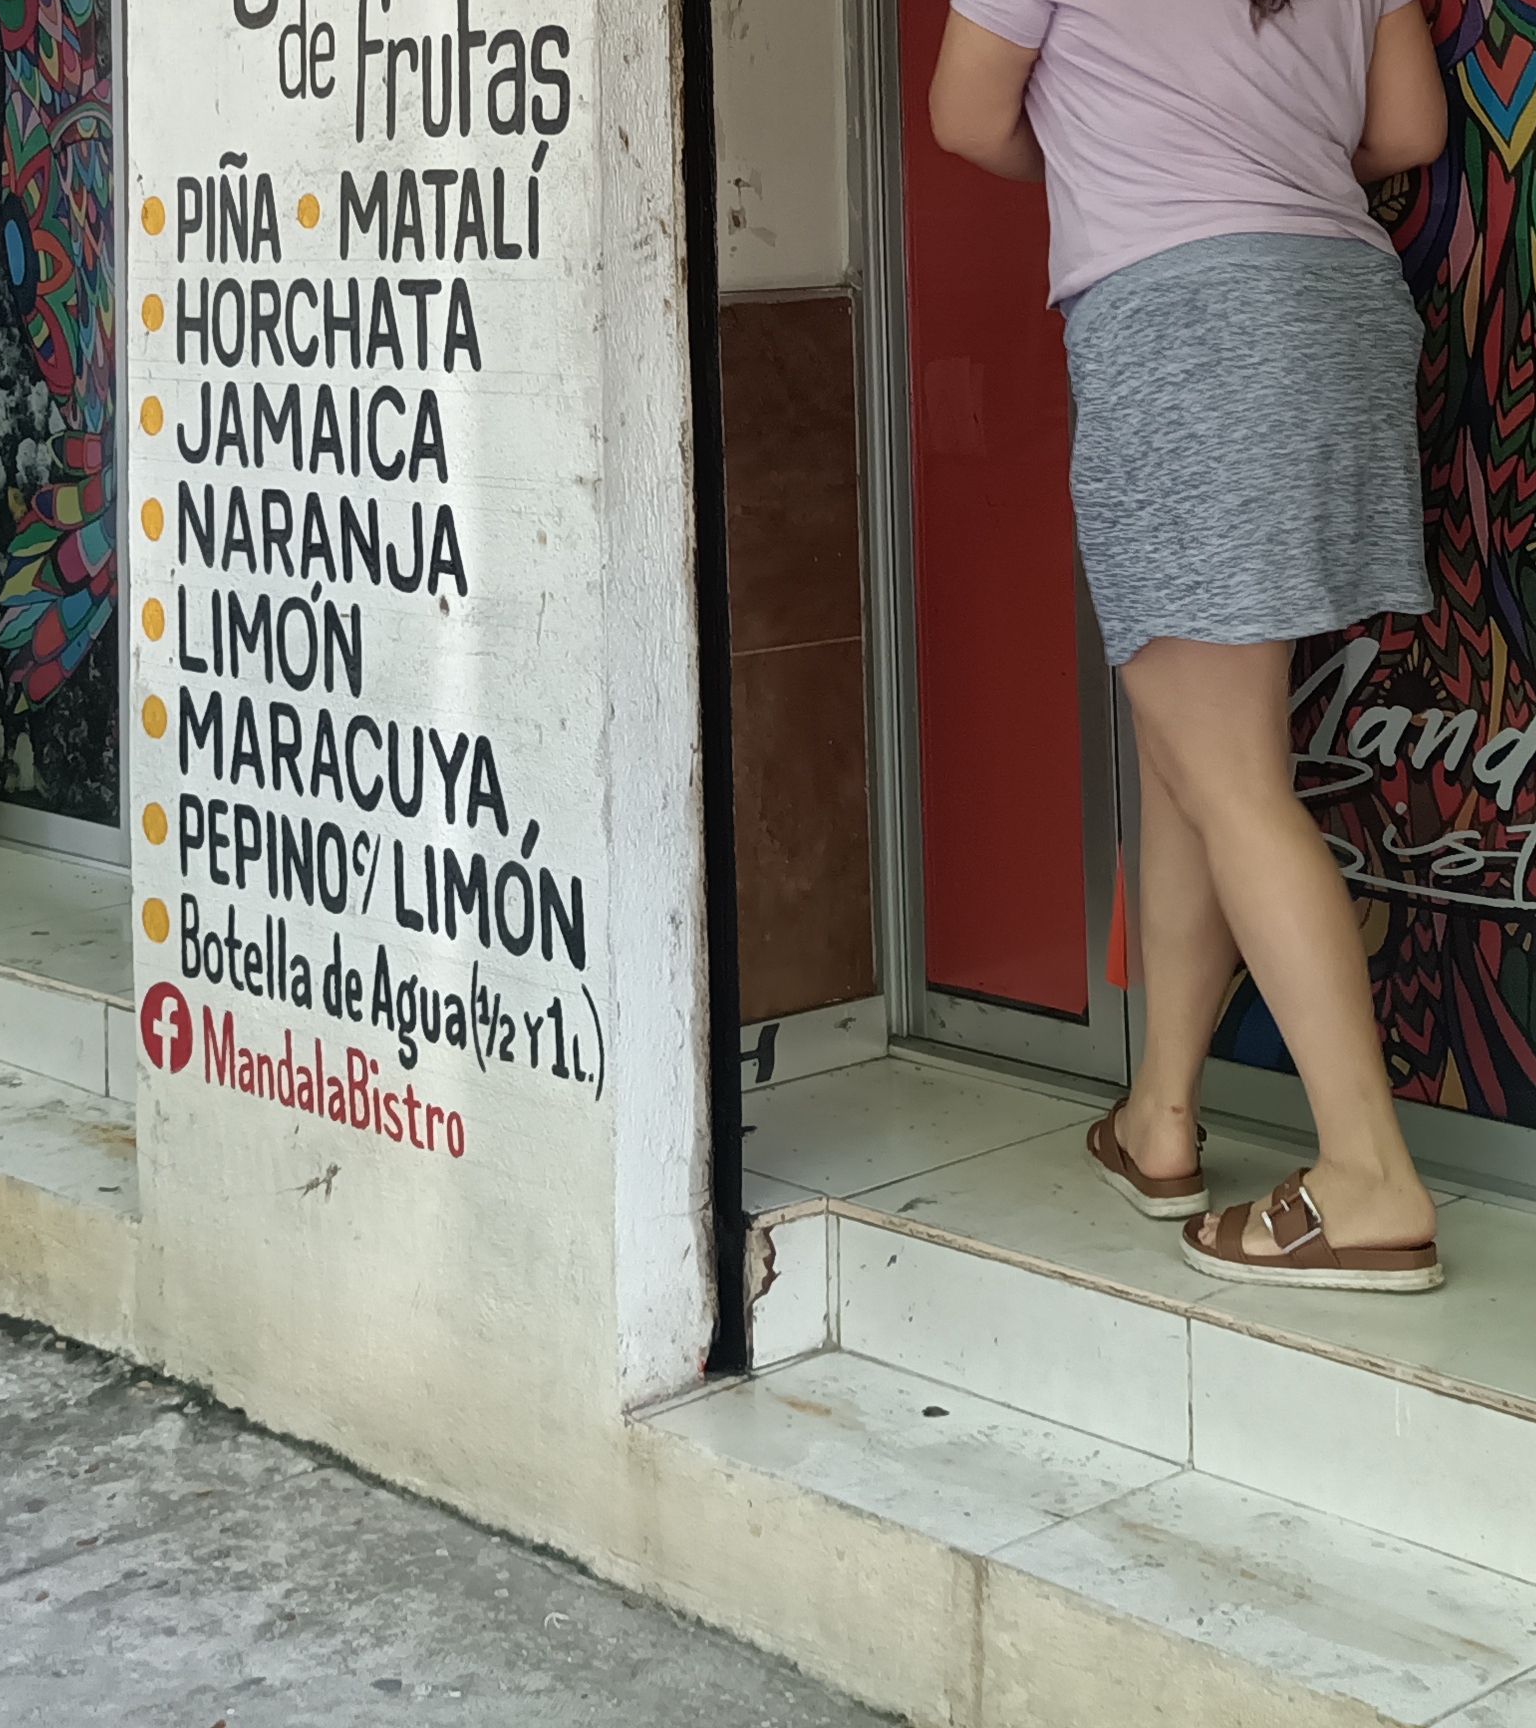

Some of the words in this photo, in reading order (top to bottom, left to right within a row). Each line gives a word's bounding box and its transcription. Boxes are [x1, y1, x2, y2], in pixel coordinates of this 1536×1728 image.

[177, 151, 282, 263] PIÑA
[340, 140, 549, 263] MATALÍ
[176, 276, 482, 374] HORCHATA
[176, 381, 448, 483] JAMAICA
[178, 480, 468, 597] NARANJA
[177, 582, 363, 697] LIMÓN
[178, 686, 509, 836] MARACUYA
[394, 819, 586, 972] LIMÓN
[181, 893, 312, 1010] Botella
[322, 933, 364, 1022] de
[203, 1004, 465, 1159] MandalaBistro
